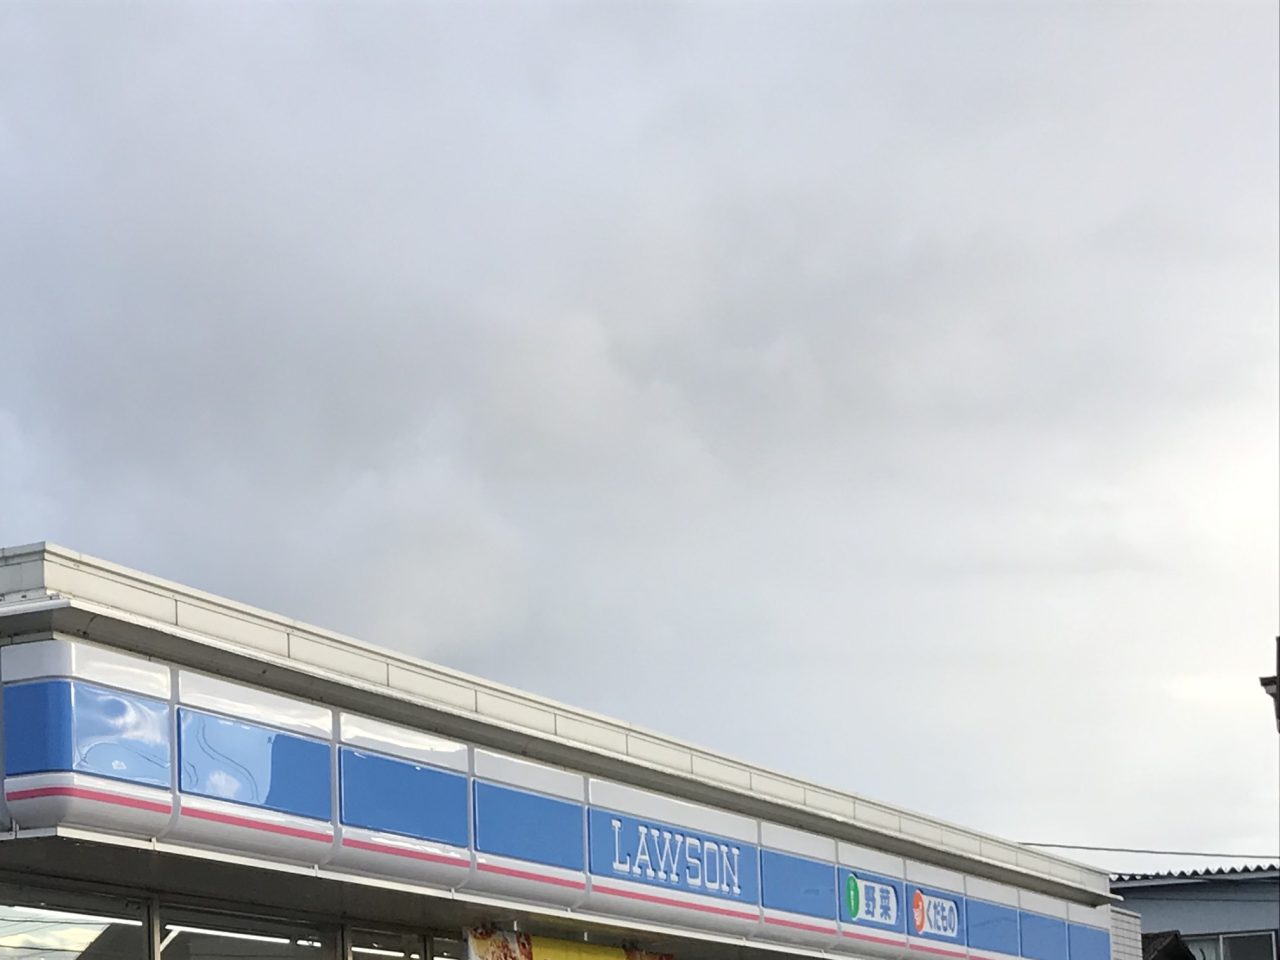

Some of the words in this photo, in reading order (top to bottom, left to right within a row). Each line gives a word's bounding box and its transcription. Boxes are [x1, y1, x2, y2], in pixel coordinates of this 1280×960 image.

[611, 819, 741, 895] LAWSON
[864, 884, 892, 920] 野菜
[926, 899, 956, 933] くだもの
